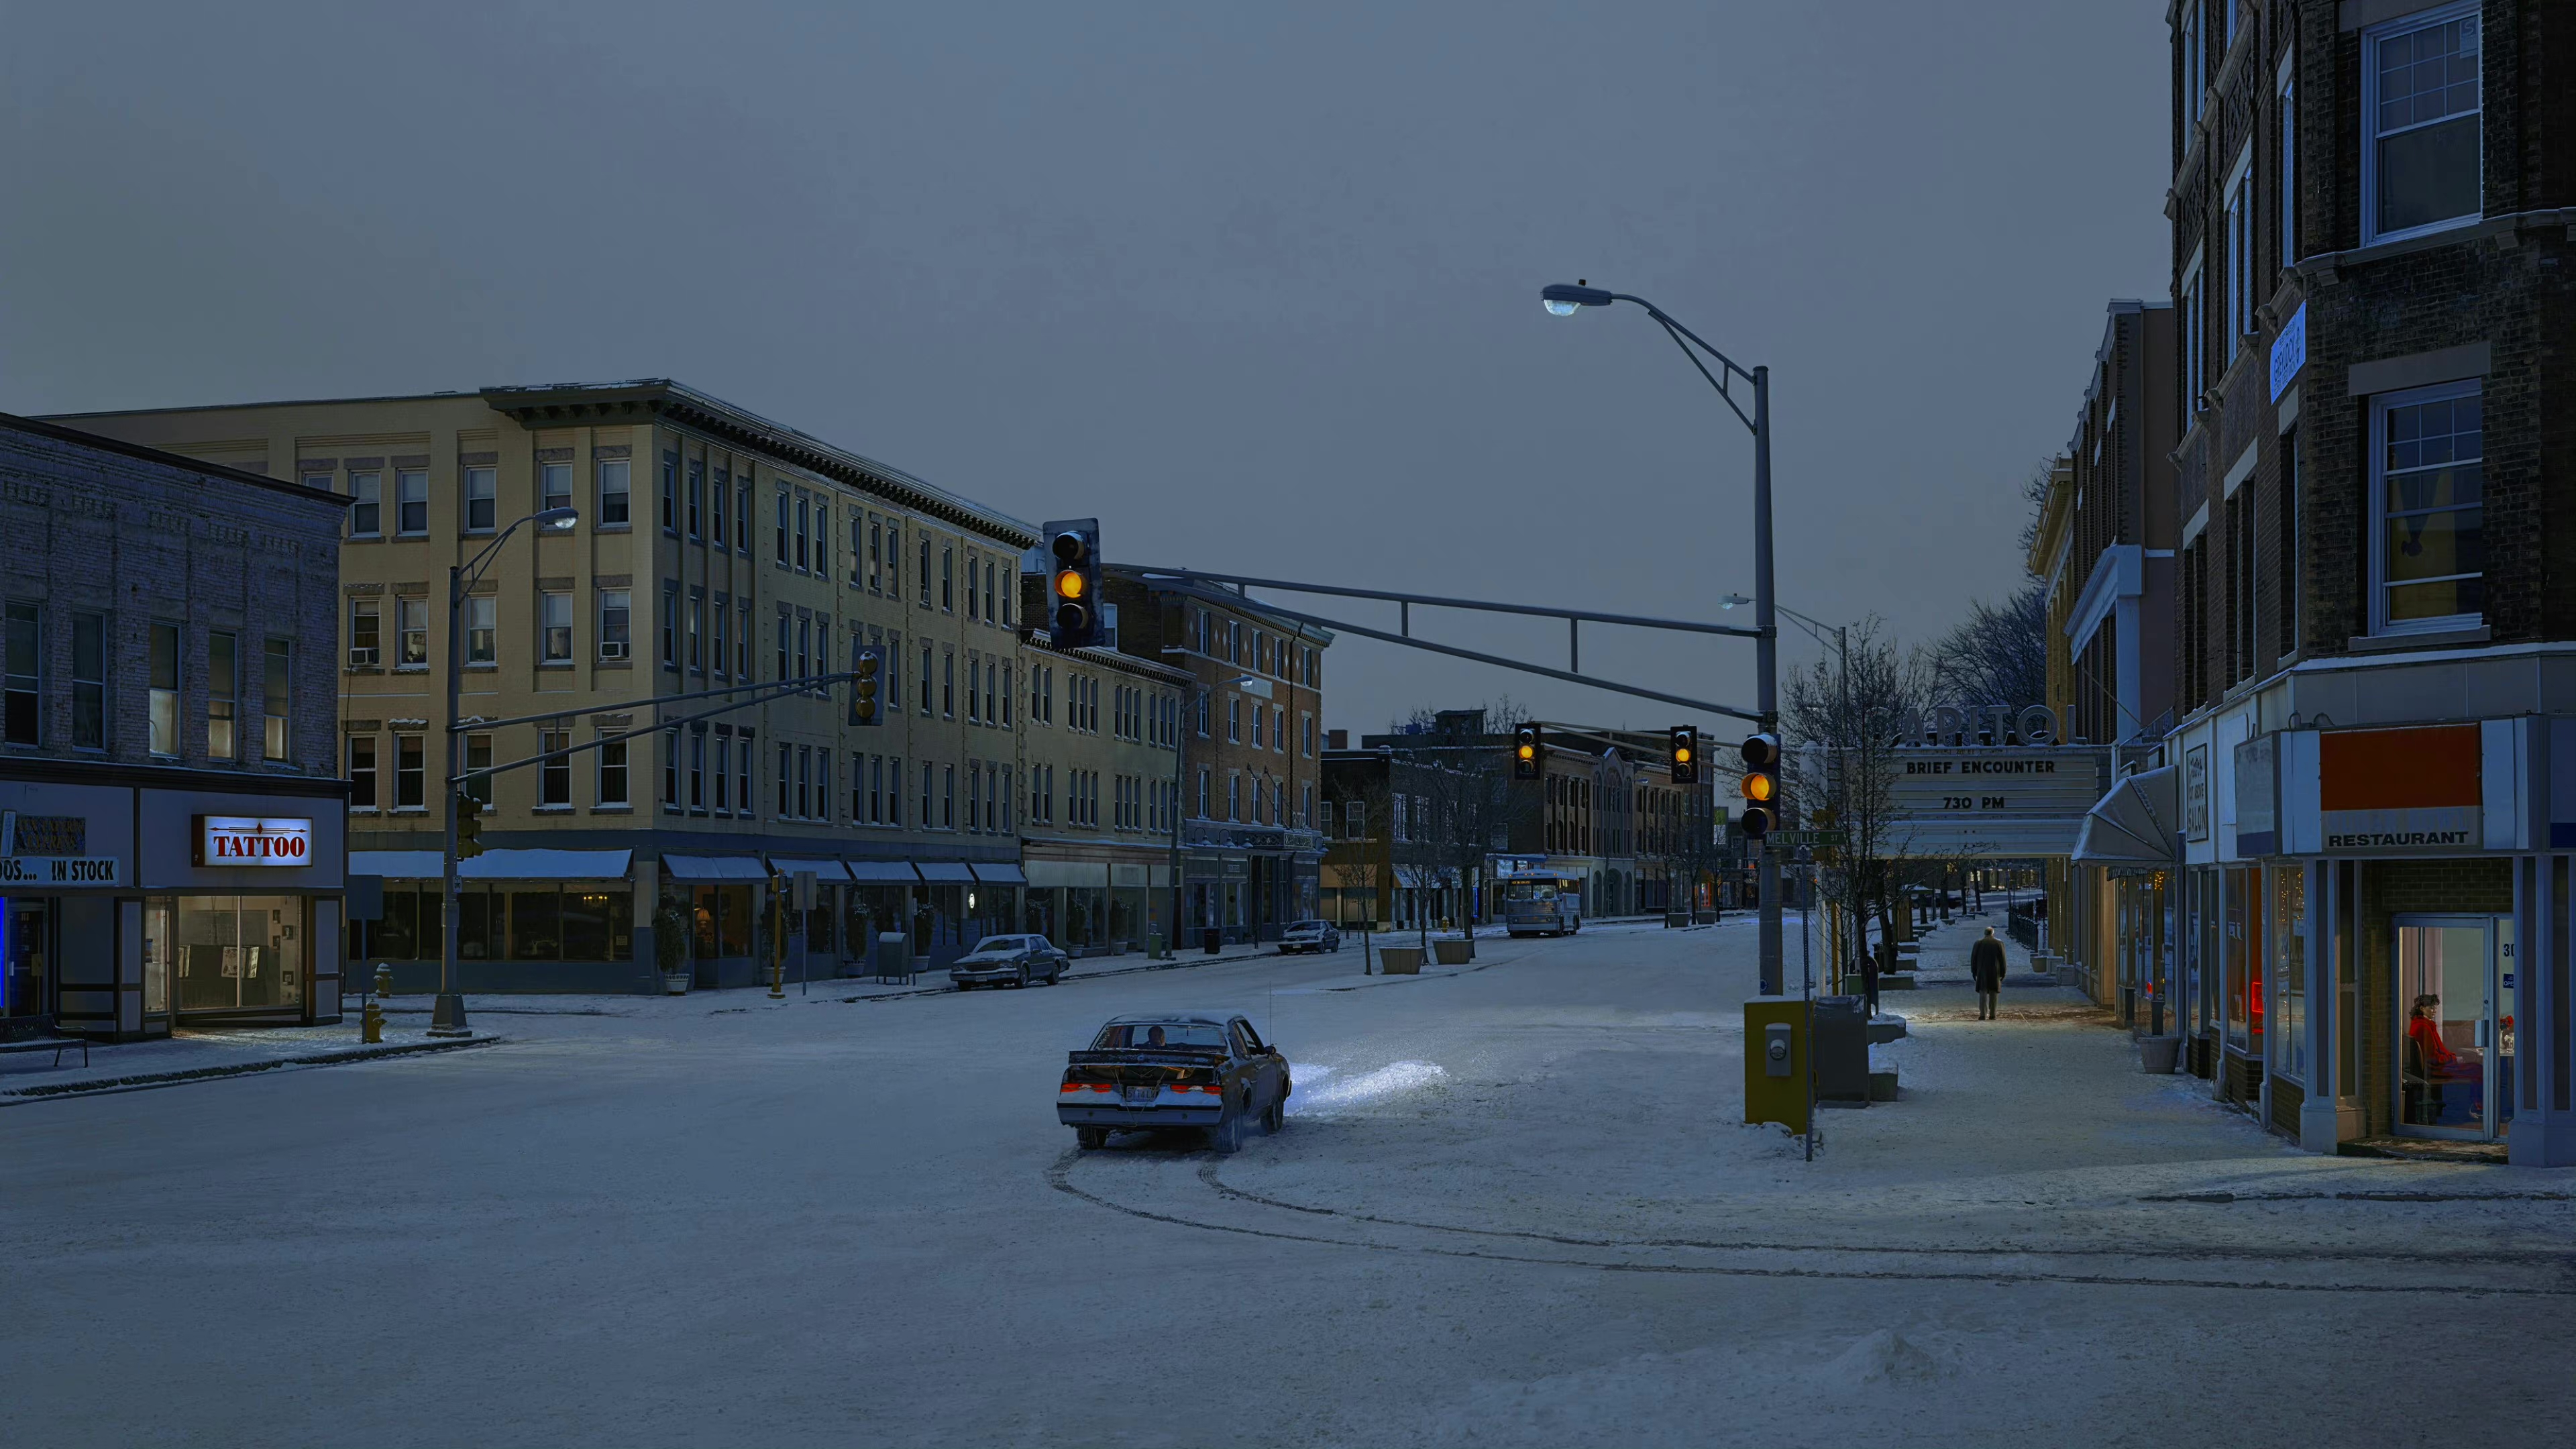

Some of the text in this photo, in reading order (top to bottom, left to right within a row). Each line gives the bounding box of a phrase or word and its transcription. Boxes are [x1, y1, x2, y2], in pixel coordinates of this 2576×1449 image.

[1907, 760, 2055, 773] BRIEF ENCOUNTER
[1943, 796, 2005, 809] 730 PM
[2188, 804, 2206, 833] SALON
[213, 836, 305, 857] TATTOO
[1766, 832, 1820, 845] MELVILLE
[2328, 830, 2469, 847] RESTAURANT
[52, 860, 66, 881] IN
[71, 860, 114, 881] STOCK
